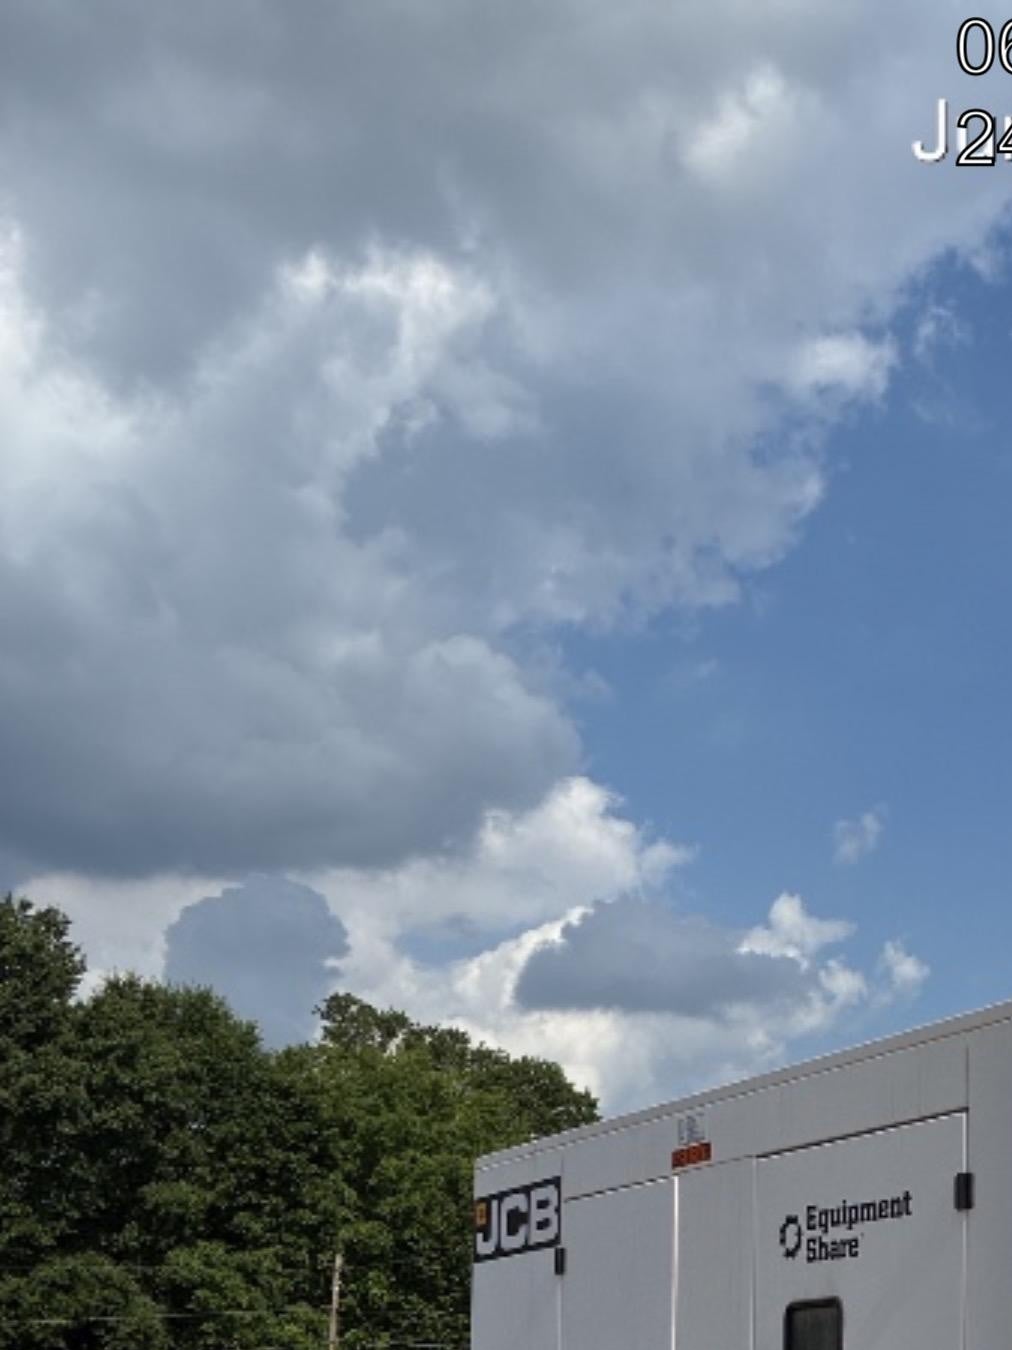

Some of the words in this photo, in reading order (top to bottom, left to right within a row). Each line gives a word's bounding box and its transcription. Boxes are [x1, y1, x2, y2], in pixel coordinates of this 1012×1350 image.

[475, 1184, 560, 1255] JCB
[806, 1190, 912, 1234] Equipment
[806, 1236, 859, 1263] Share
